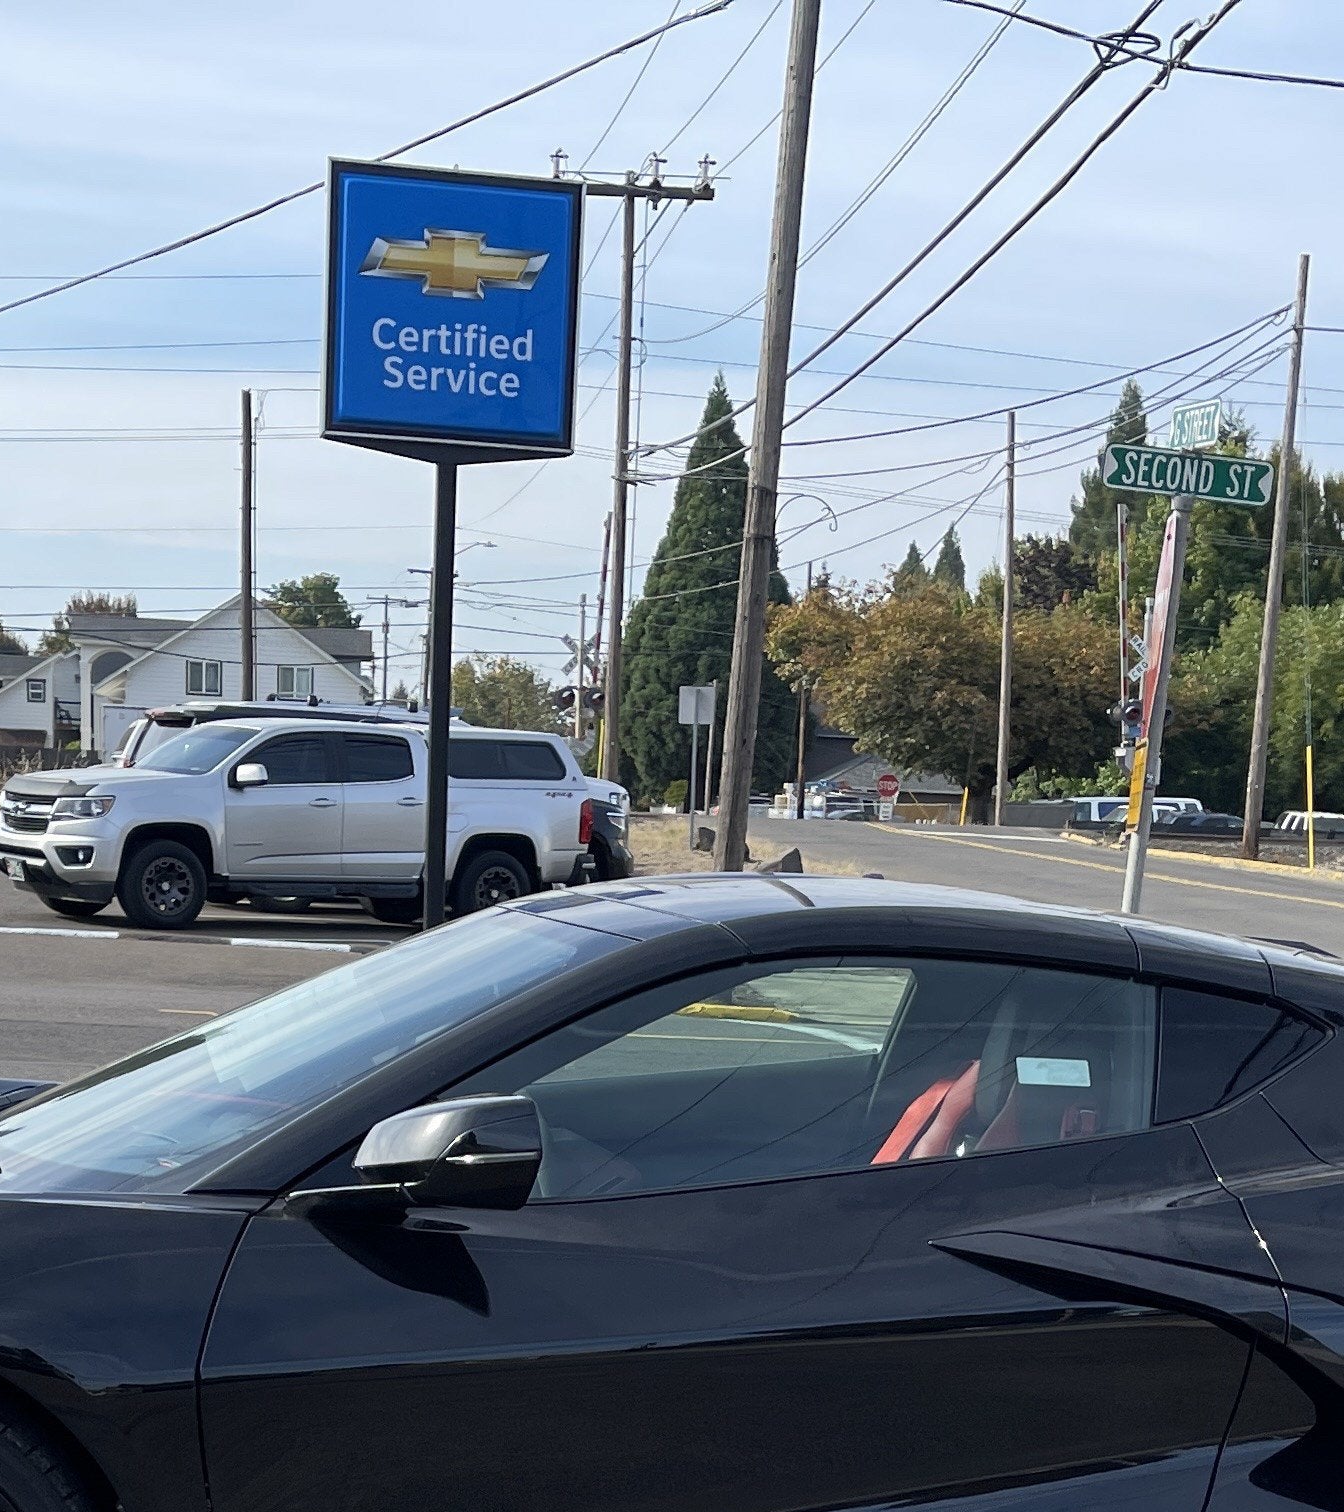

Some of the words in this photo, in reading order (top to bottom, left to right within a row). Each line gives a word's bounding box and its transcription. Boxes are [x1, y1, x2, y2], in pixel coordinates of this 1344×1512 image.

[372, 317, 533, 362] Certified
[383, 356, 521, 398] Service
[1182, 405, 1216, 444] STREET
[1121, 451, 1215, 493] SECOND
[1226, 464, 1256, 498] ST
[878, 780, 898, 791] STOP
